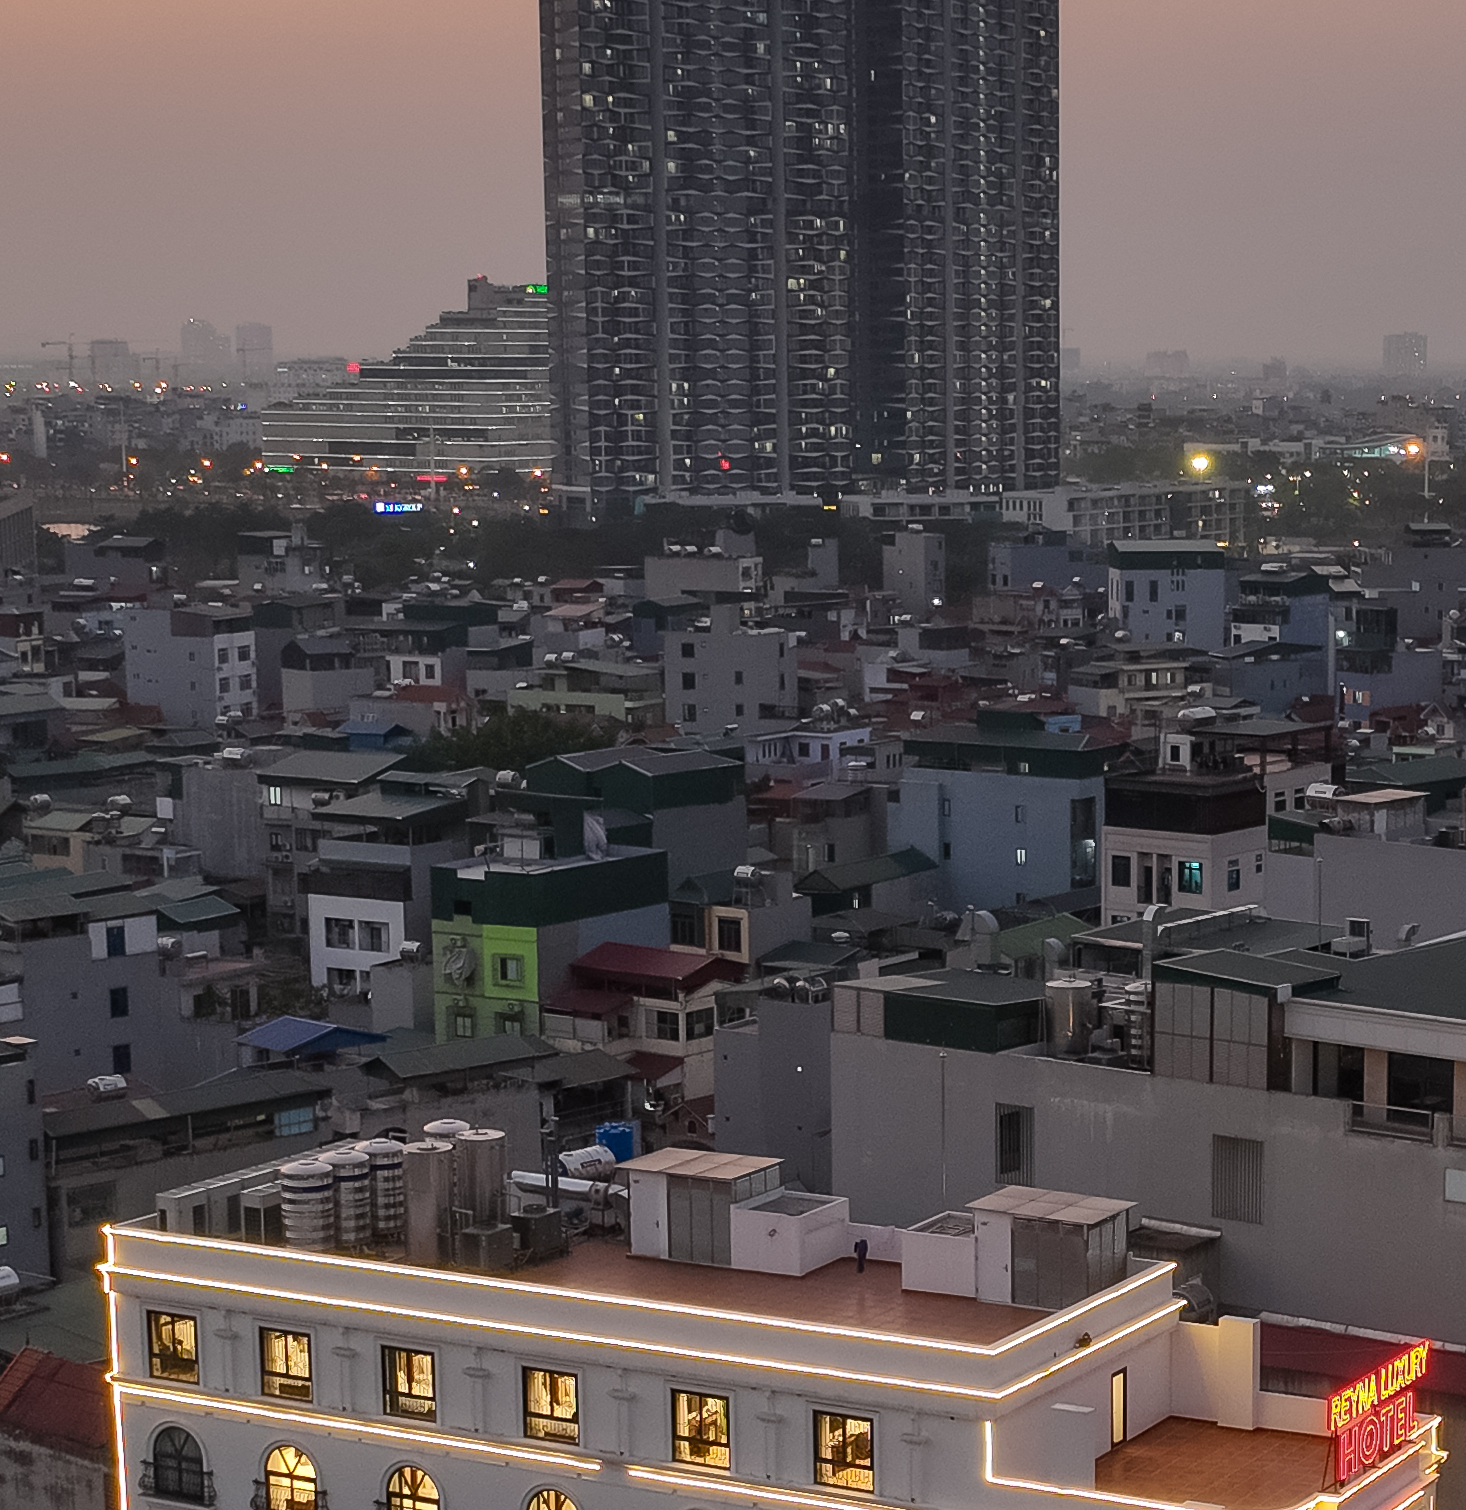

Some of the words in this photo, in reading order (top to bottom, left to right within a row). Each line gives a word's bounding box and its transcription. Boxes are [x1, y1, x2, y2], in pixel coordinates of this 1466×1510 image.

[1330, 1372, 1378, 1431] REYNA
[1380, 1341, 1430, 1400] LUXURY
[1337, 1391, 1418, 1482] HOTEL
